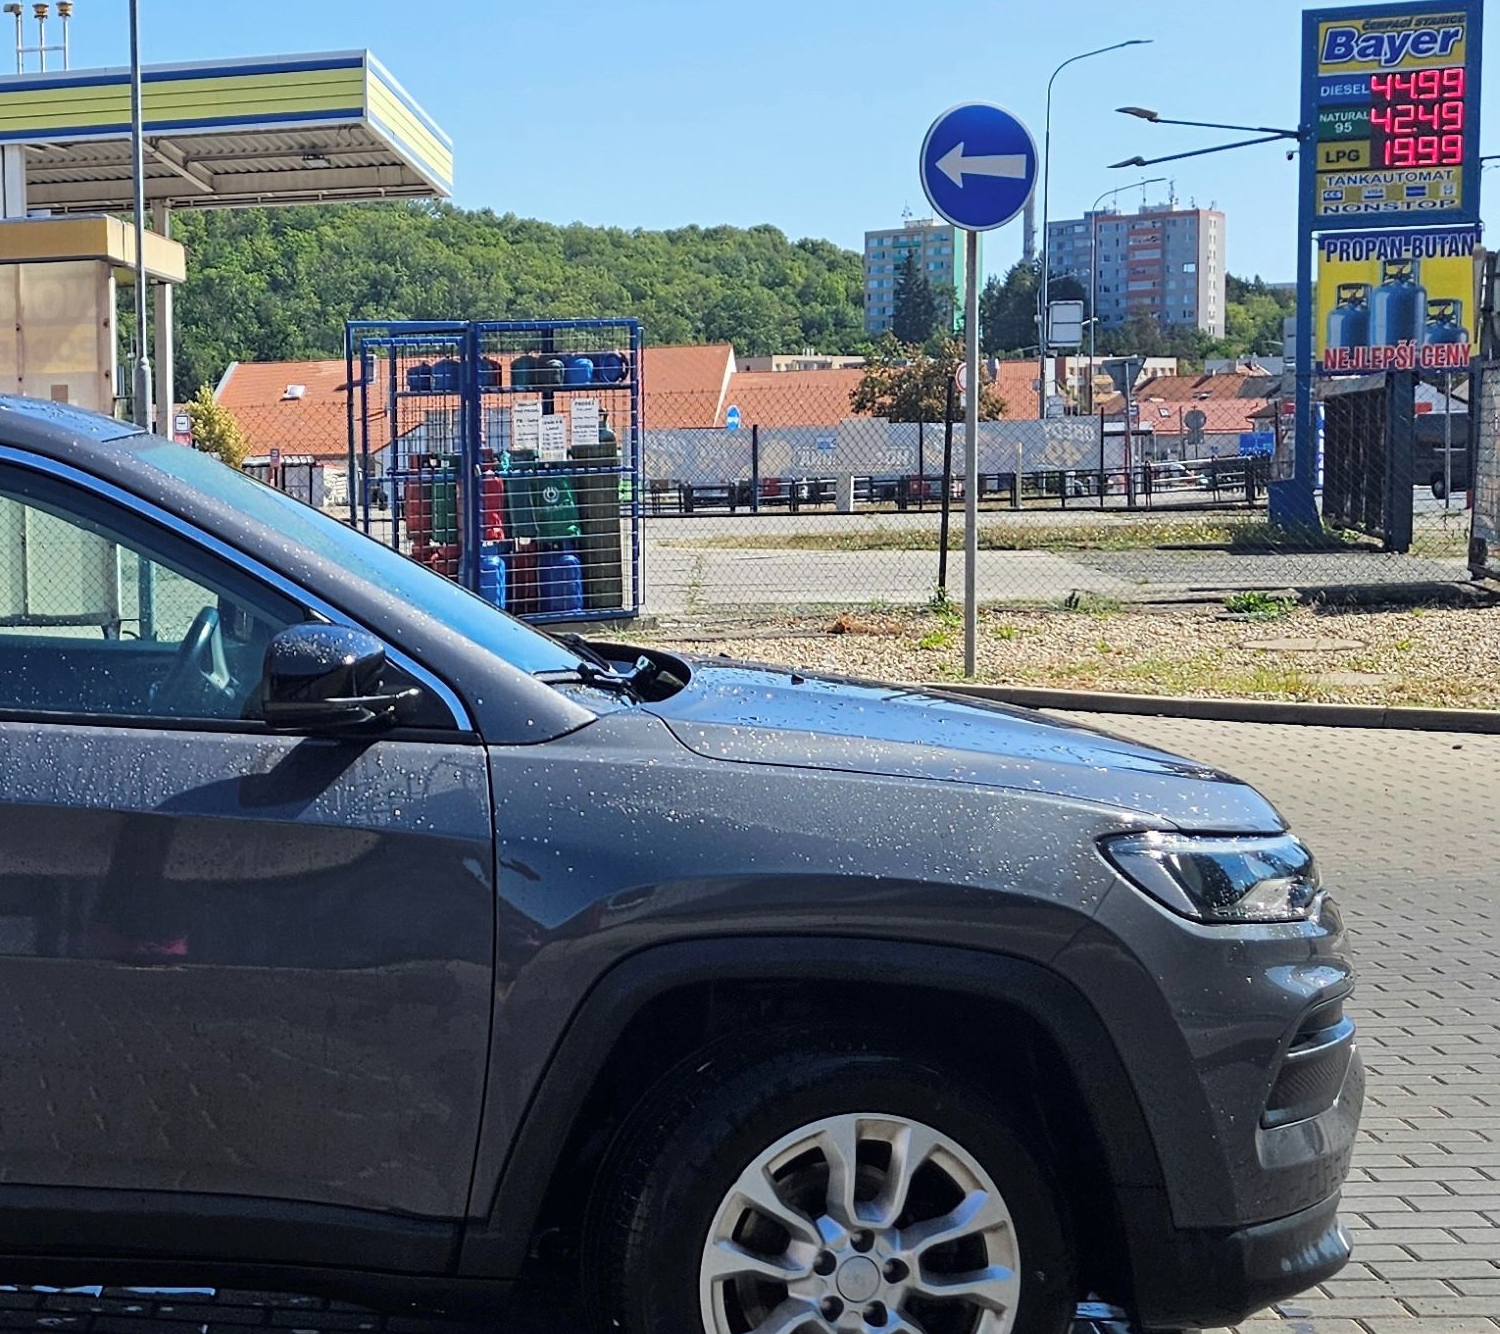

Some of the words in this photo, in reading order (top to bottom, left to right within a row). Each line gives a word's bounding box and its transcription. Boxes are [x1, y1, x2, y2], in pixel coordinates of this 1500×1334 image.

[1321, 26, 1464, 67] Bayer
[1320, 84, 1370, 97] DIESEL
[1319, 110, 1369, 122] NATURAL
[1334, 123, 1352, 133] 95
[1325, 150, 1360, 163] LPG
[1326, 170, 1453, 186] TANKAUTOMAT
[1324, 200, 1456, 214] NONSTOP
[1325, 233, 1475, 262] PROPAN-BUTAN
[1323, 340, 1416, 369] NEJLEPŠÍ
[1421, 343, 1472, 368] CENY
